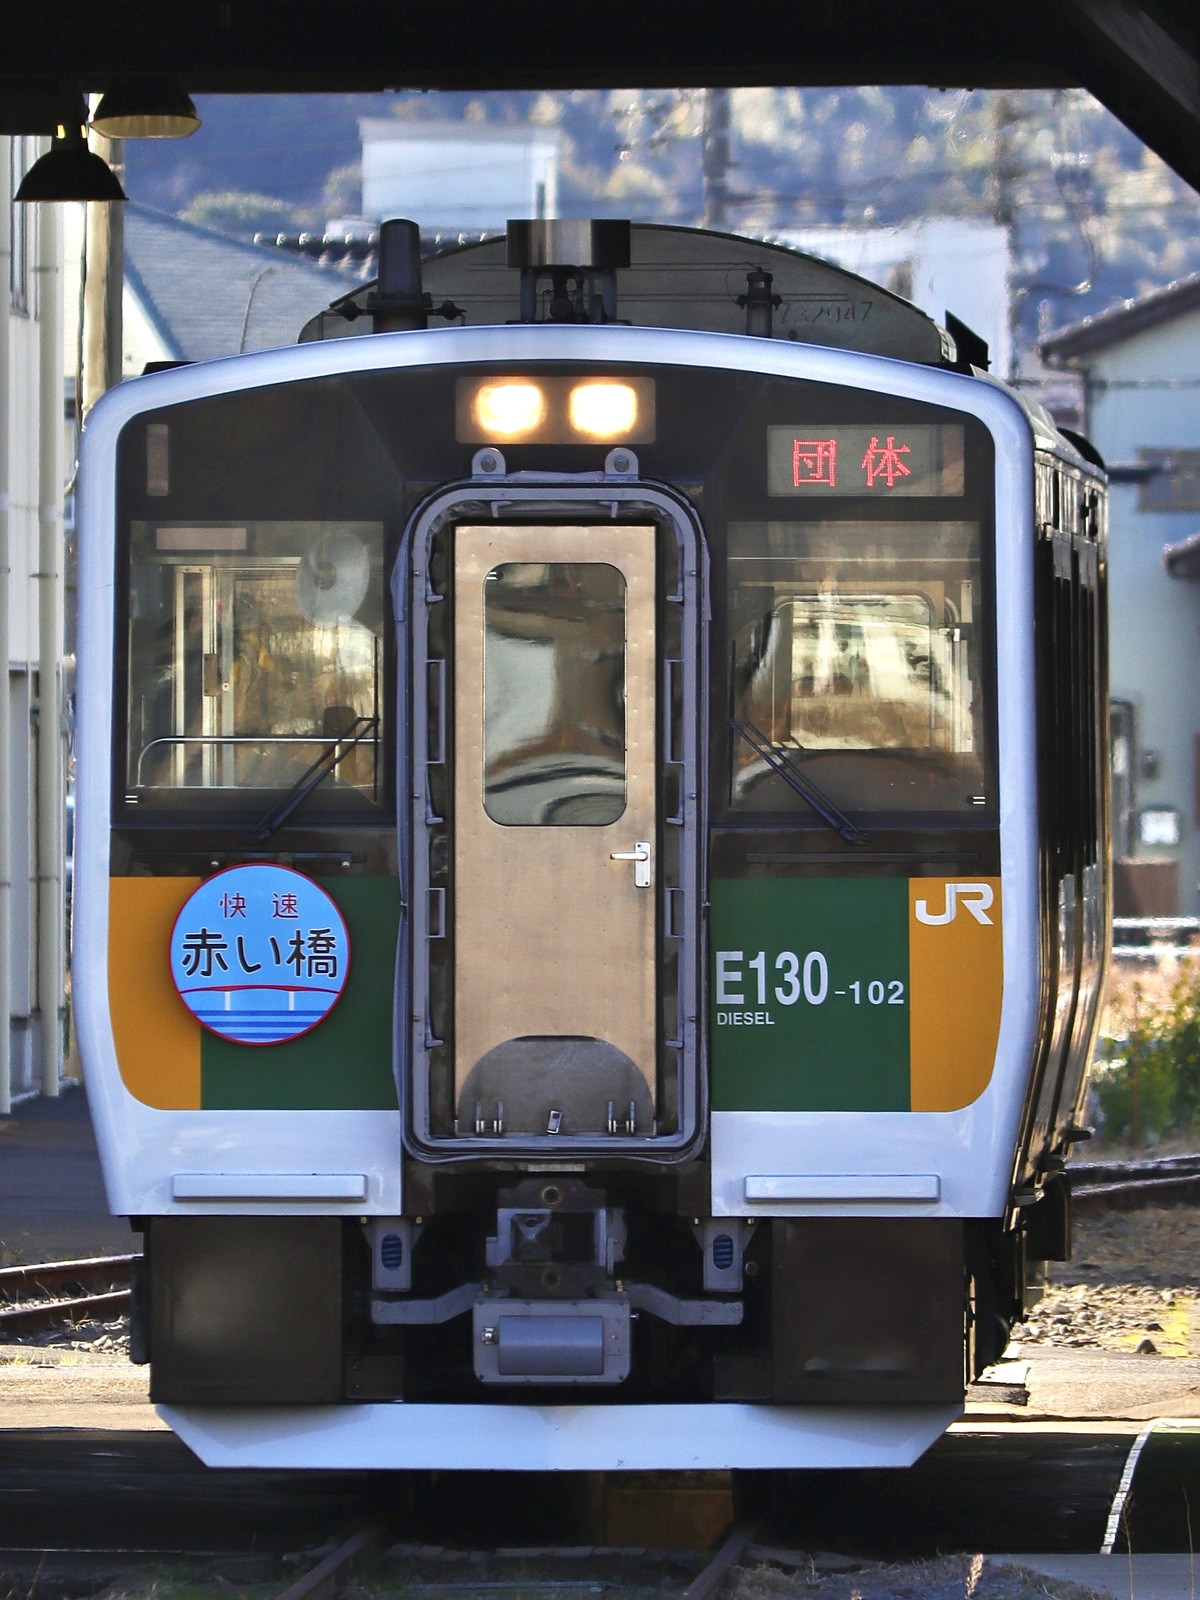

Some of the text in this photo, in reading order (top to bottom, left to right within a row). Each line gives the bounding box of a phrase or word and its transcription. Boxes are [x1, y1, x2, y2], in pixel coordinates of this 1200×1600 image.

[792, 436, 911, 487] 団体
[219, 892, 300, 919] 快速
[915, 883, 995, 926] JR
[181, 927, 339, 978] 赤い橋
[716, 1011, 775, 1026] DIESEL
